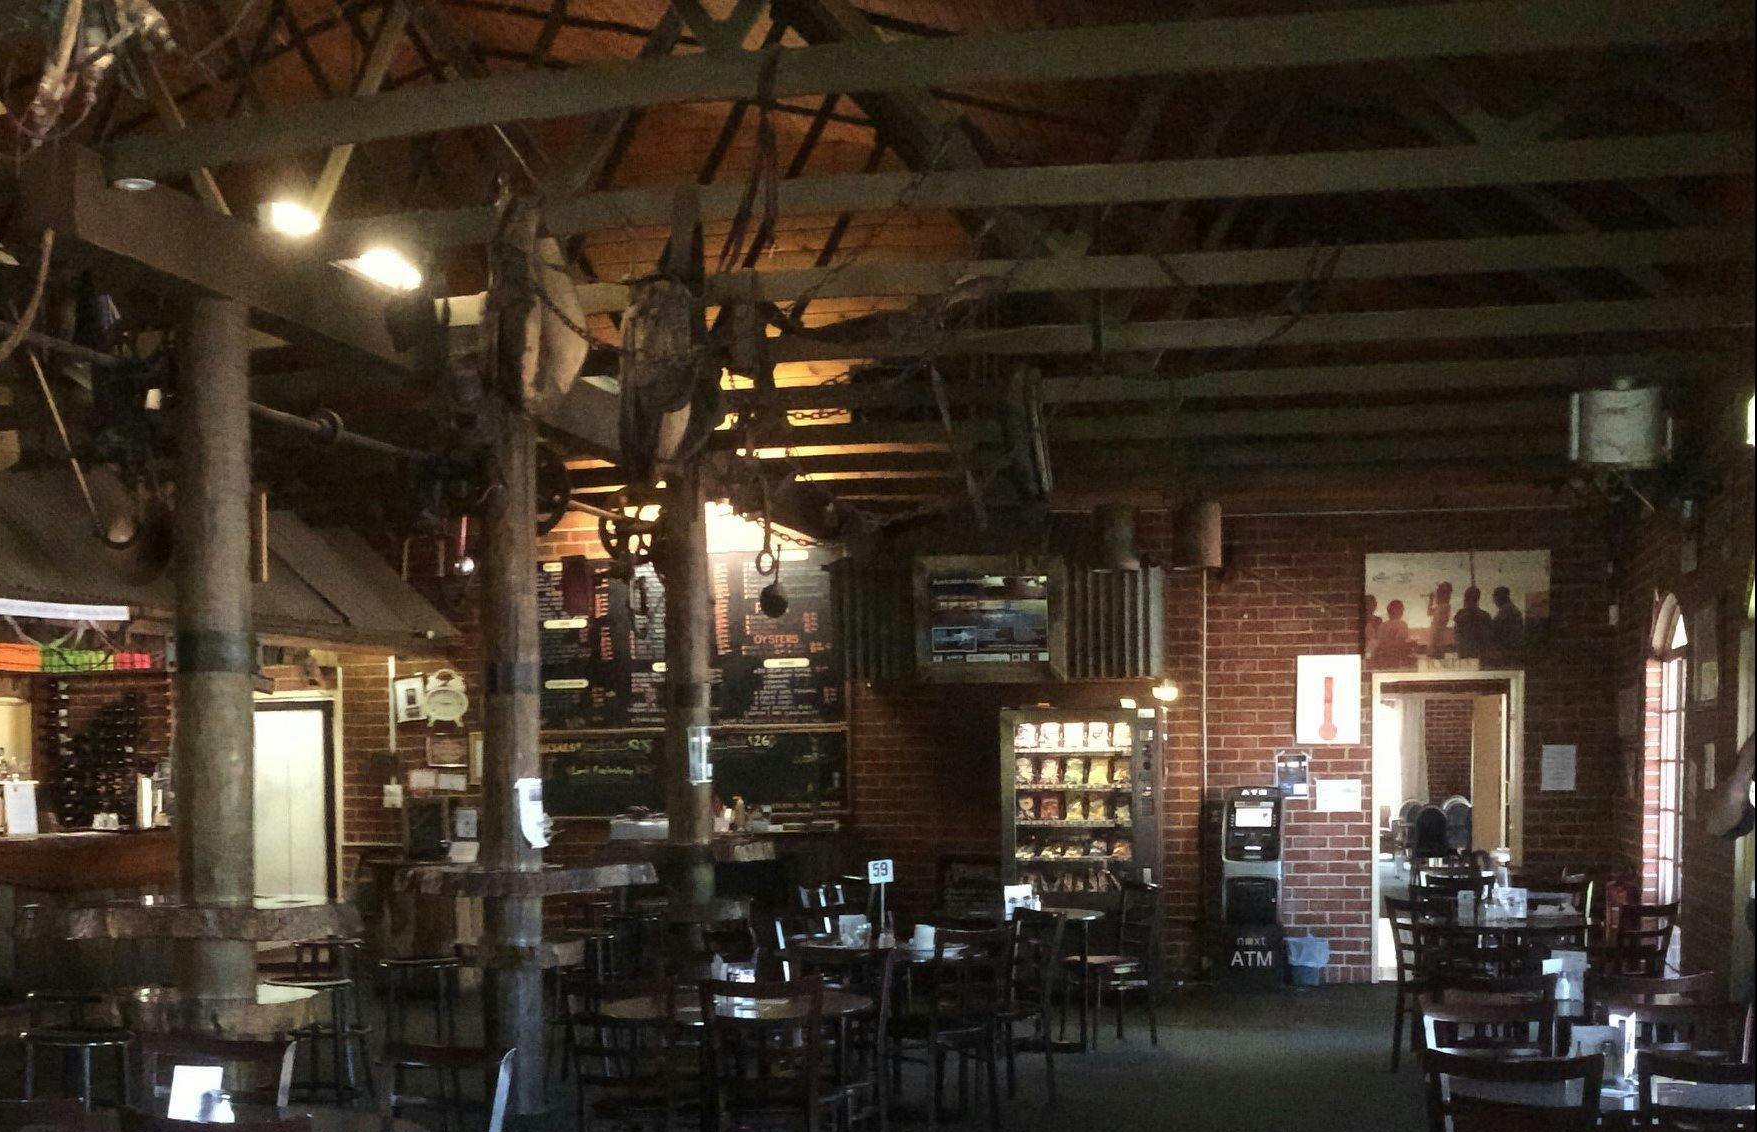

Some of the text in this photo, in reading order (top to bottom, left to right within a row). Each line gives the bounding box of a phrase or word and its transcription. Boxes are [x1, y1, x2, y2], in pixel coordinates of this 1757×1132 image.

[753, 634, 799, 644] OYSTERS
[873, 862, 888, 877] 59
[1230, 950, 1273, 967] ATM
